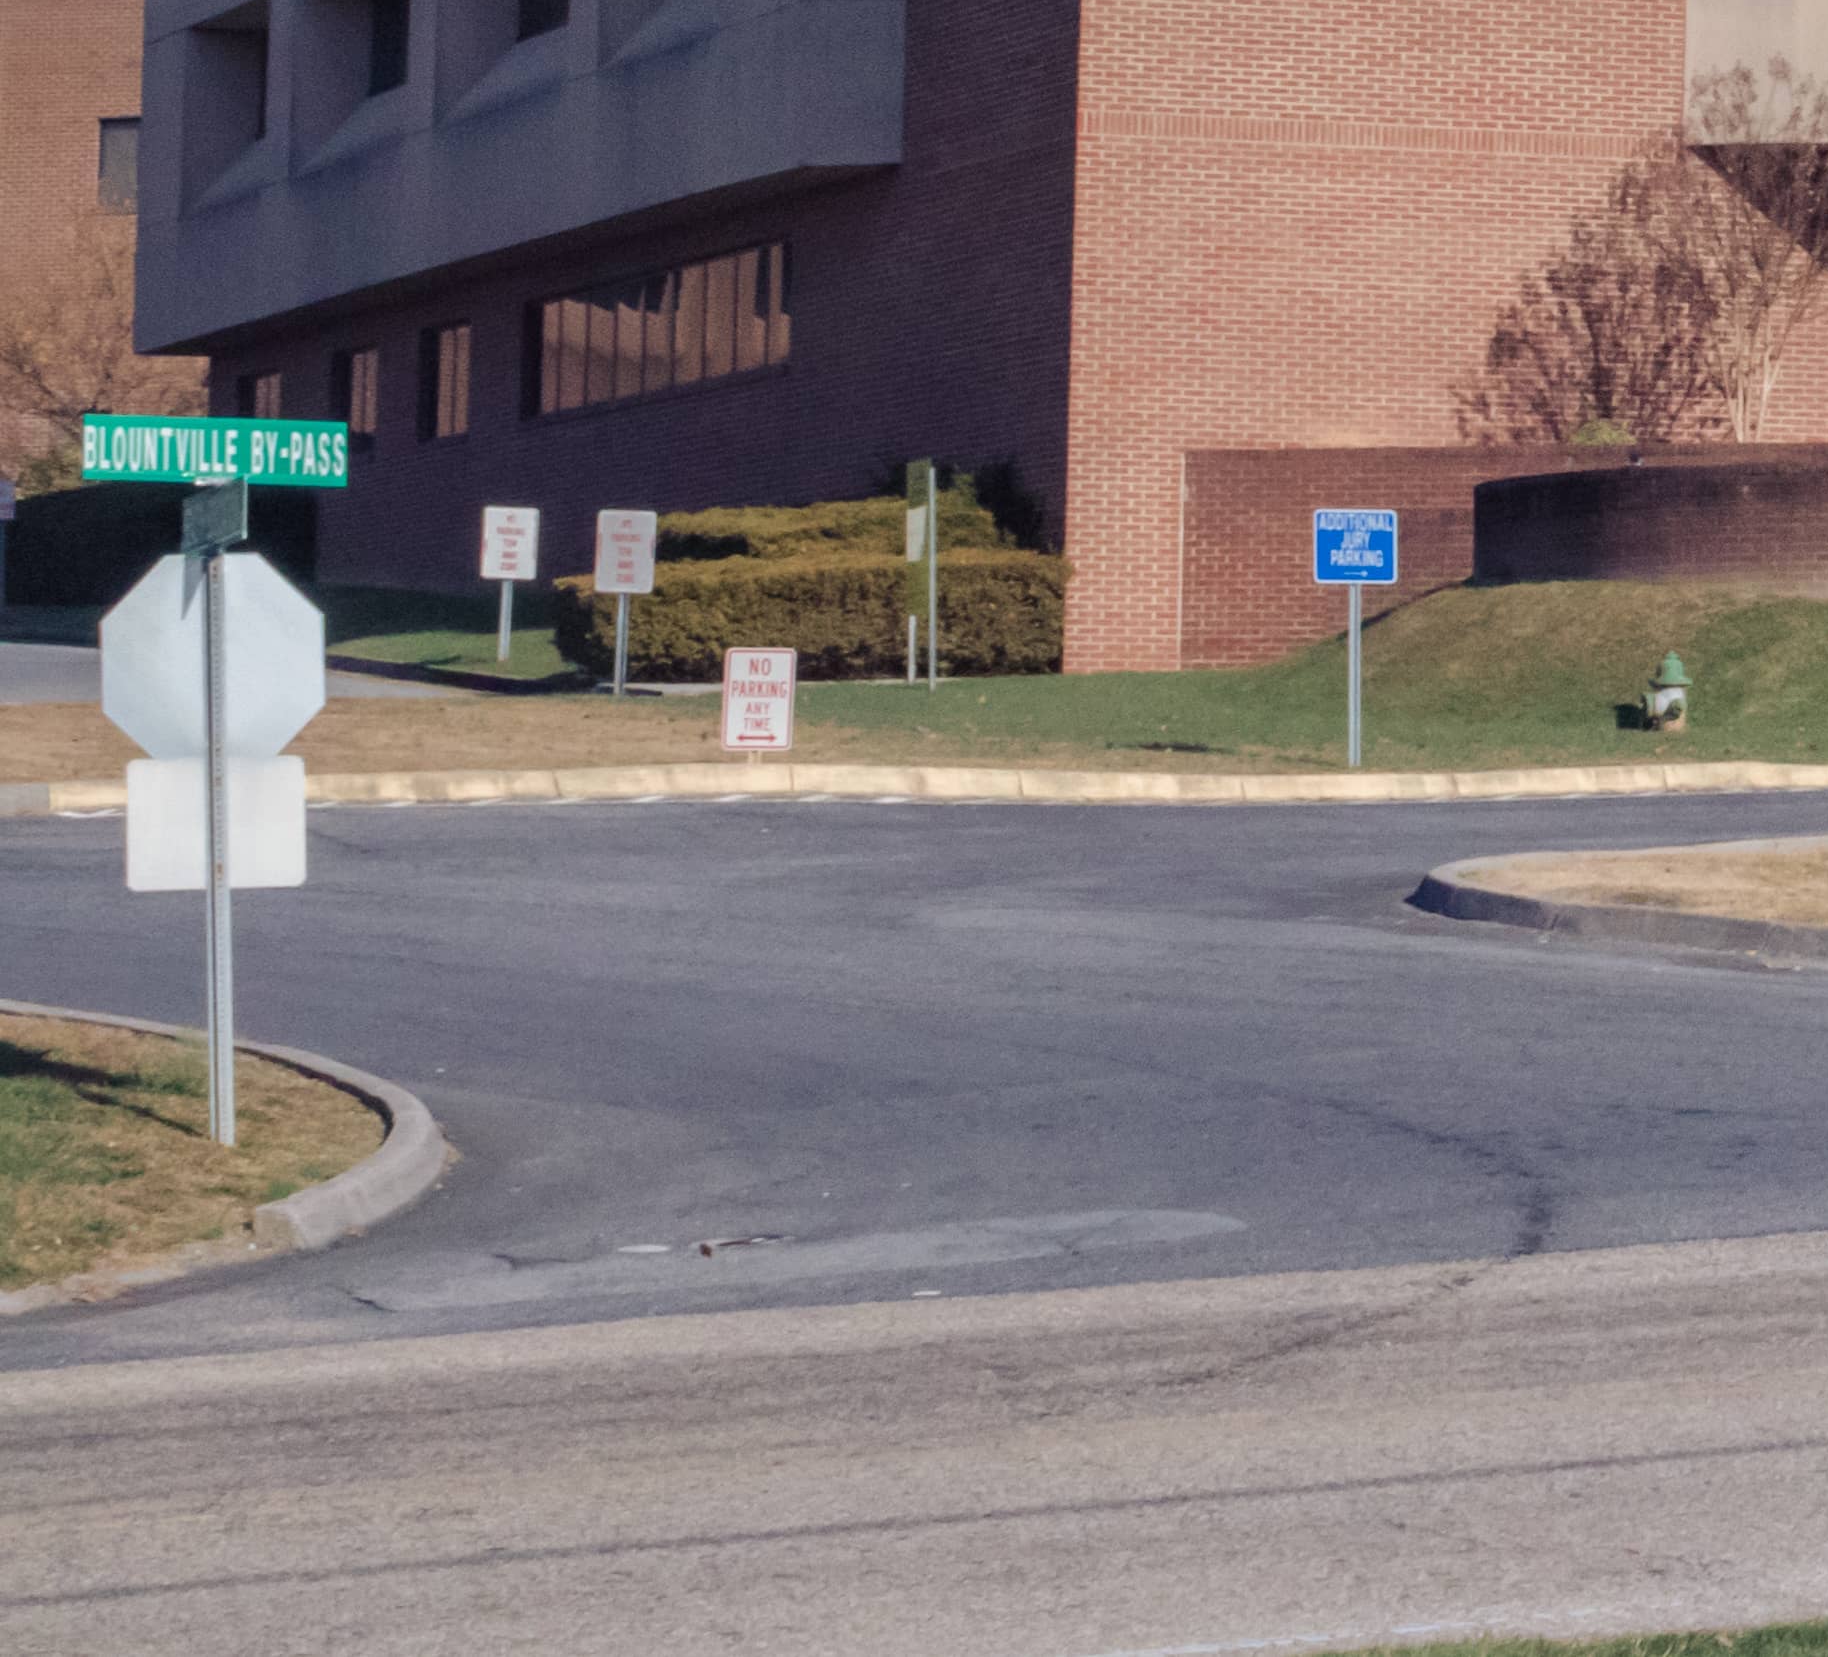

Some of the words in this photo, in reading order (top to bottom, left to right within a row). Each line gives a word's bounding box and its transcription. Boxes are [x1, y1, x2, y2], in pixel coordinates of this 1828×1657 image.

[83, 425, 238, 473] BLOUNTVILLE
[251, 430, 347, 476] BY-PASS
[1319, 512, 1392, 532] ADDITIONAL
[1341, 531, 1371, 550] JURY
[1330, 549, 1383, 567] PARKING
[749, 658, 772, 675] NO
[730, 680, 787, 698] PARKING
[745, 702, 770, 714] ANY
[744, 717, 771, 731] TIME
